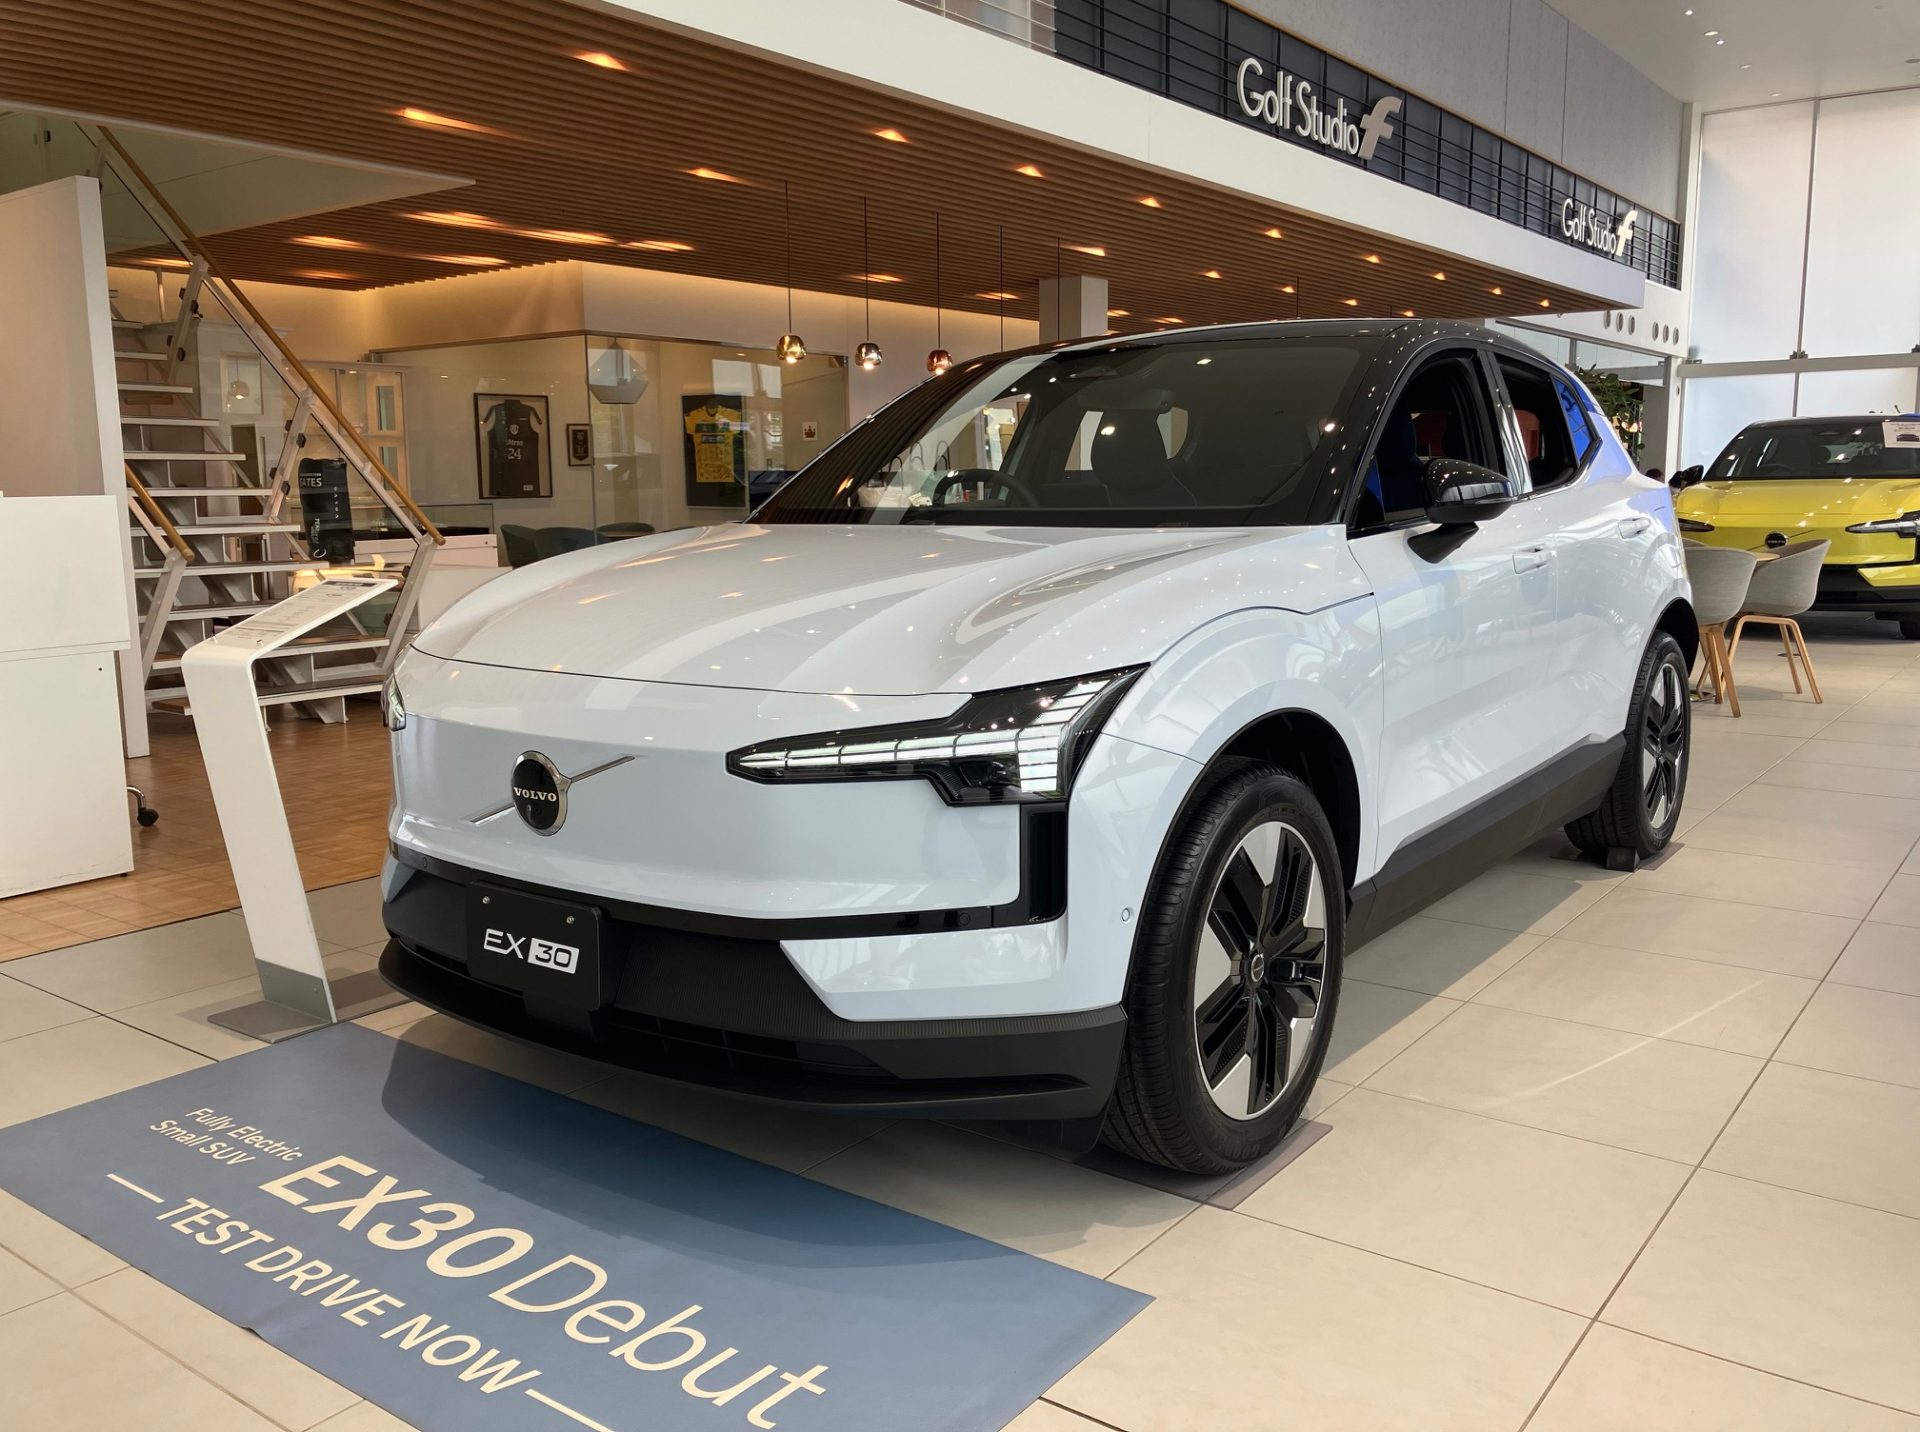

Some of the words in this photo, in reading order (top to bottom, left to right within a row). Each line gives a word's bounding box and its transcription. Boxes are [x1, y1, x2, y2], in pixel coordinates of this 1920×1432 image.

[1237, 58, 1293, 129] Golf
[1295, 81, 1359, 155] Studio
[1563, 198, 1587, 242] Golf
[1587, 208, 1616, 254] Studio
[507, 447, 521, 460] 24
[514, 787, 557, 802] VOLVO
[150, 1120, 213, 1147] Small
[199, 1142, 256, 1165] SUV
[185, 1107, 236, 1131] Fully
[227, 1125, 303, 1161] Electric
[156, 1197, 275, 1255] TEST
[244, 1245, 406, 1327] DRIVE
[379, 1313, 543, 1394] NOW
[258, 1155, 534, 1278] EX30
[488, 1254, 829, 1430] Debut
